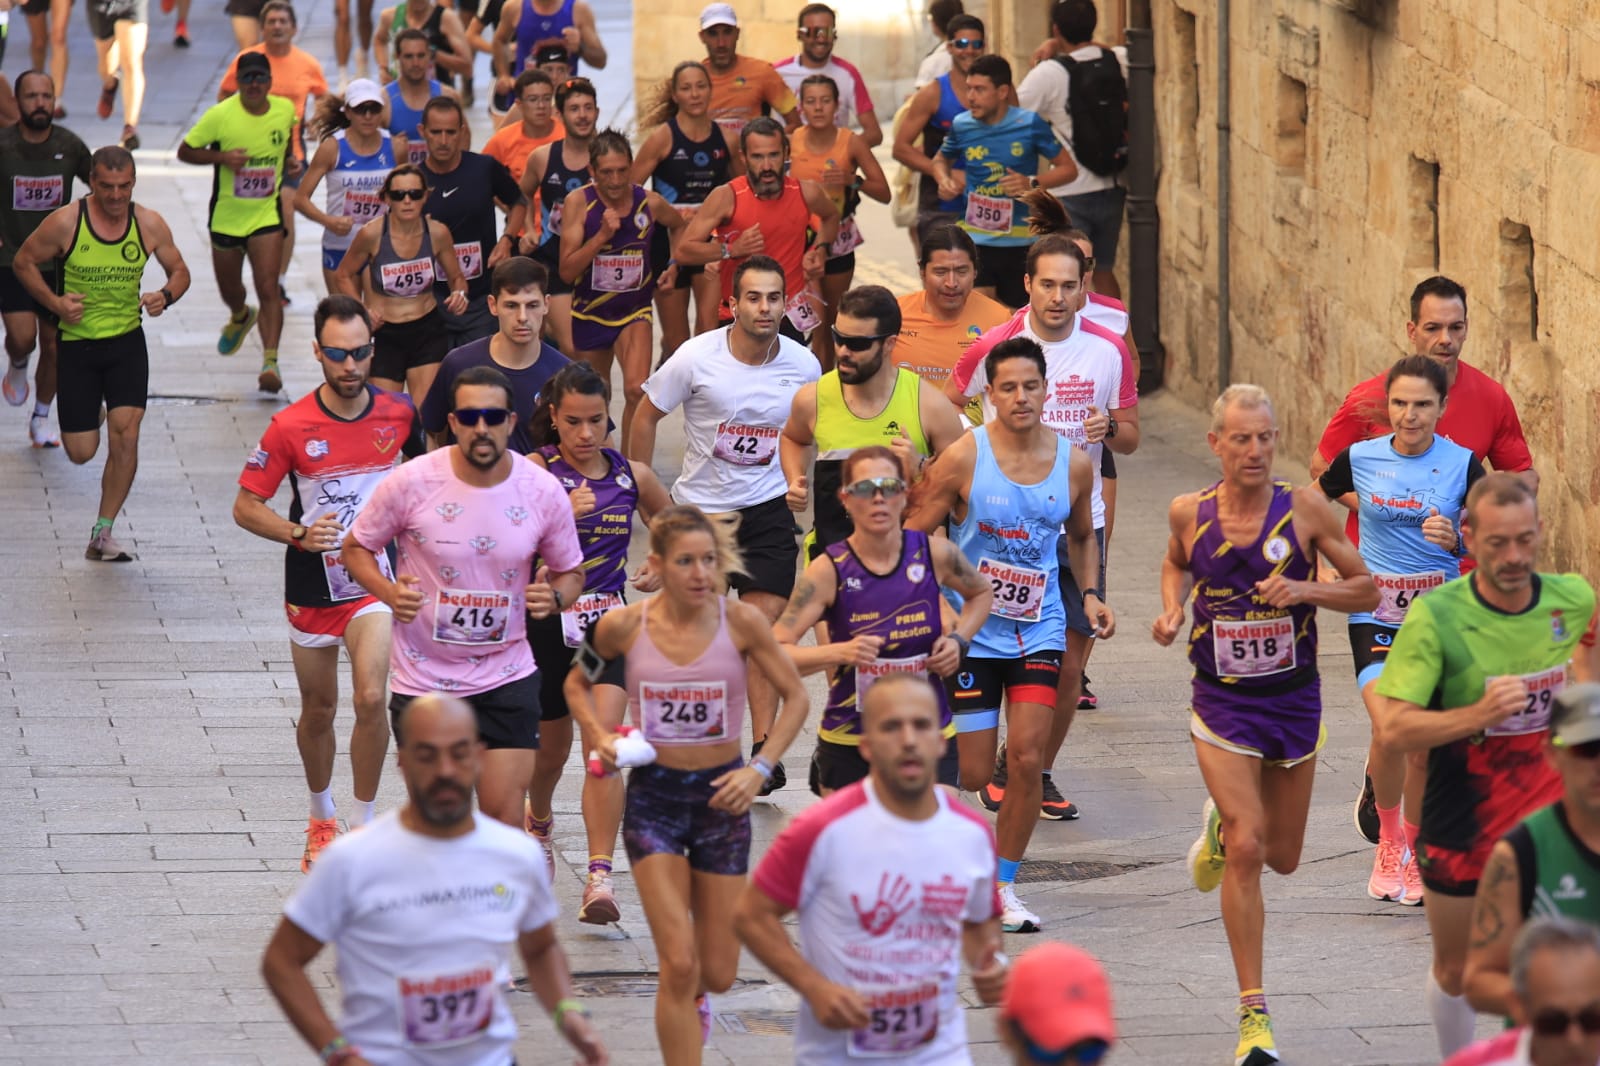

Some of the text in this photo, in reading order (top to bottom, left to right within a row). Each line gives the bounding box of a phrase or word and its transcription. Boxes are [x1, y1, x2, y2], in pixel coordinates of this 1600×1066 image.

[243, 179, 268, 190] 298
[342, 177, 353, 187] LA
[25, 188, 53, 200] 382
[353, 202, 380, 216] 357
[975, 206, 1001, 221] 350
[383, 262, 431, 278] bedunia
[595, 256, 641, 268] bedunia
[395, 272, 424, 289] 495
[614, 267, 624, 281] 3
[718, 422, 779, 439] bedunia
[733, 436, 759, 455] 42
[602, 513, 628, 523] PRIM
[979, 560, 1046, 588] bedunia
[1373, 574, 1444, 591] bedunia
[439, 590, 510, 609] bedunia
[991, 579, 1031, 605] 238
[1395, 590, 1420, 609] 6
[451, 607, 494, 628] 416
[895, 611, 926, 626] PRIM
[1215, 623, 1293, 641] bedunia
[1231, 638, 1278, 660] 518
[643, 686, 723, 702] bedunia
[1512, 690, 1551, 716] 29
[661, 701, 707, 723] 248
[422, 989, 478, 1023] 397
[872, 1005, 922, 1035] 521
